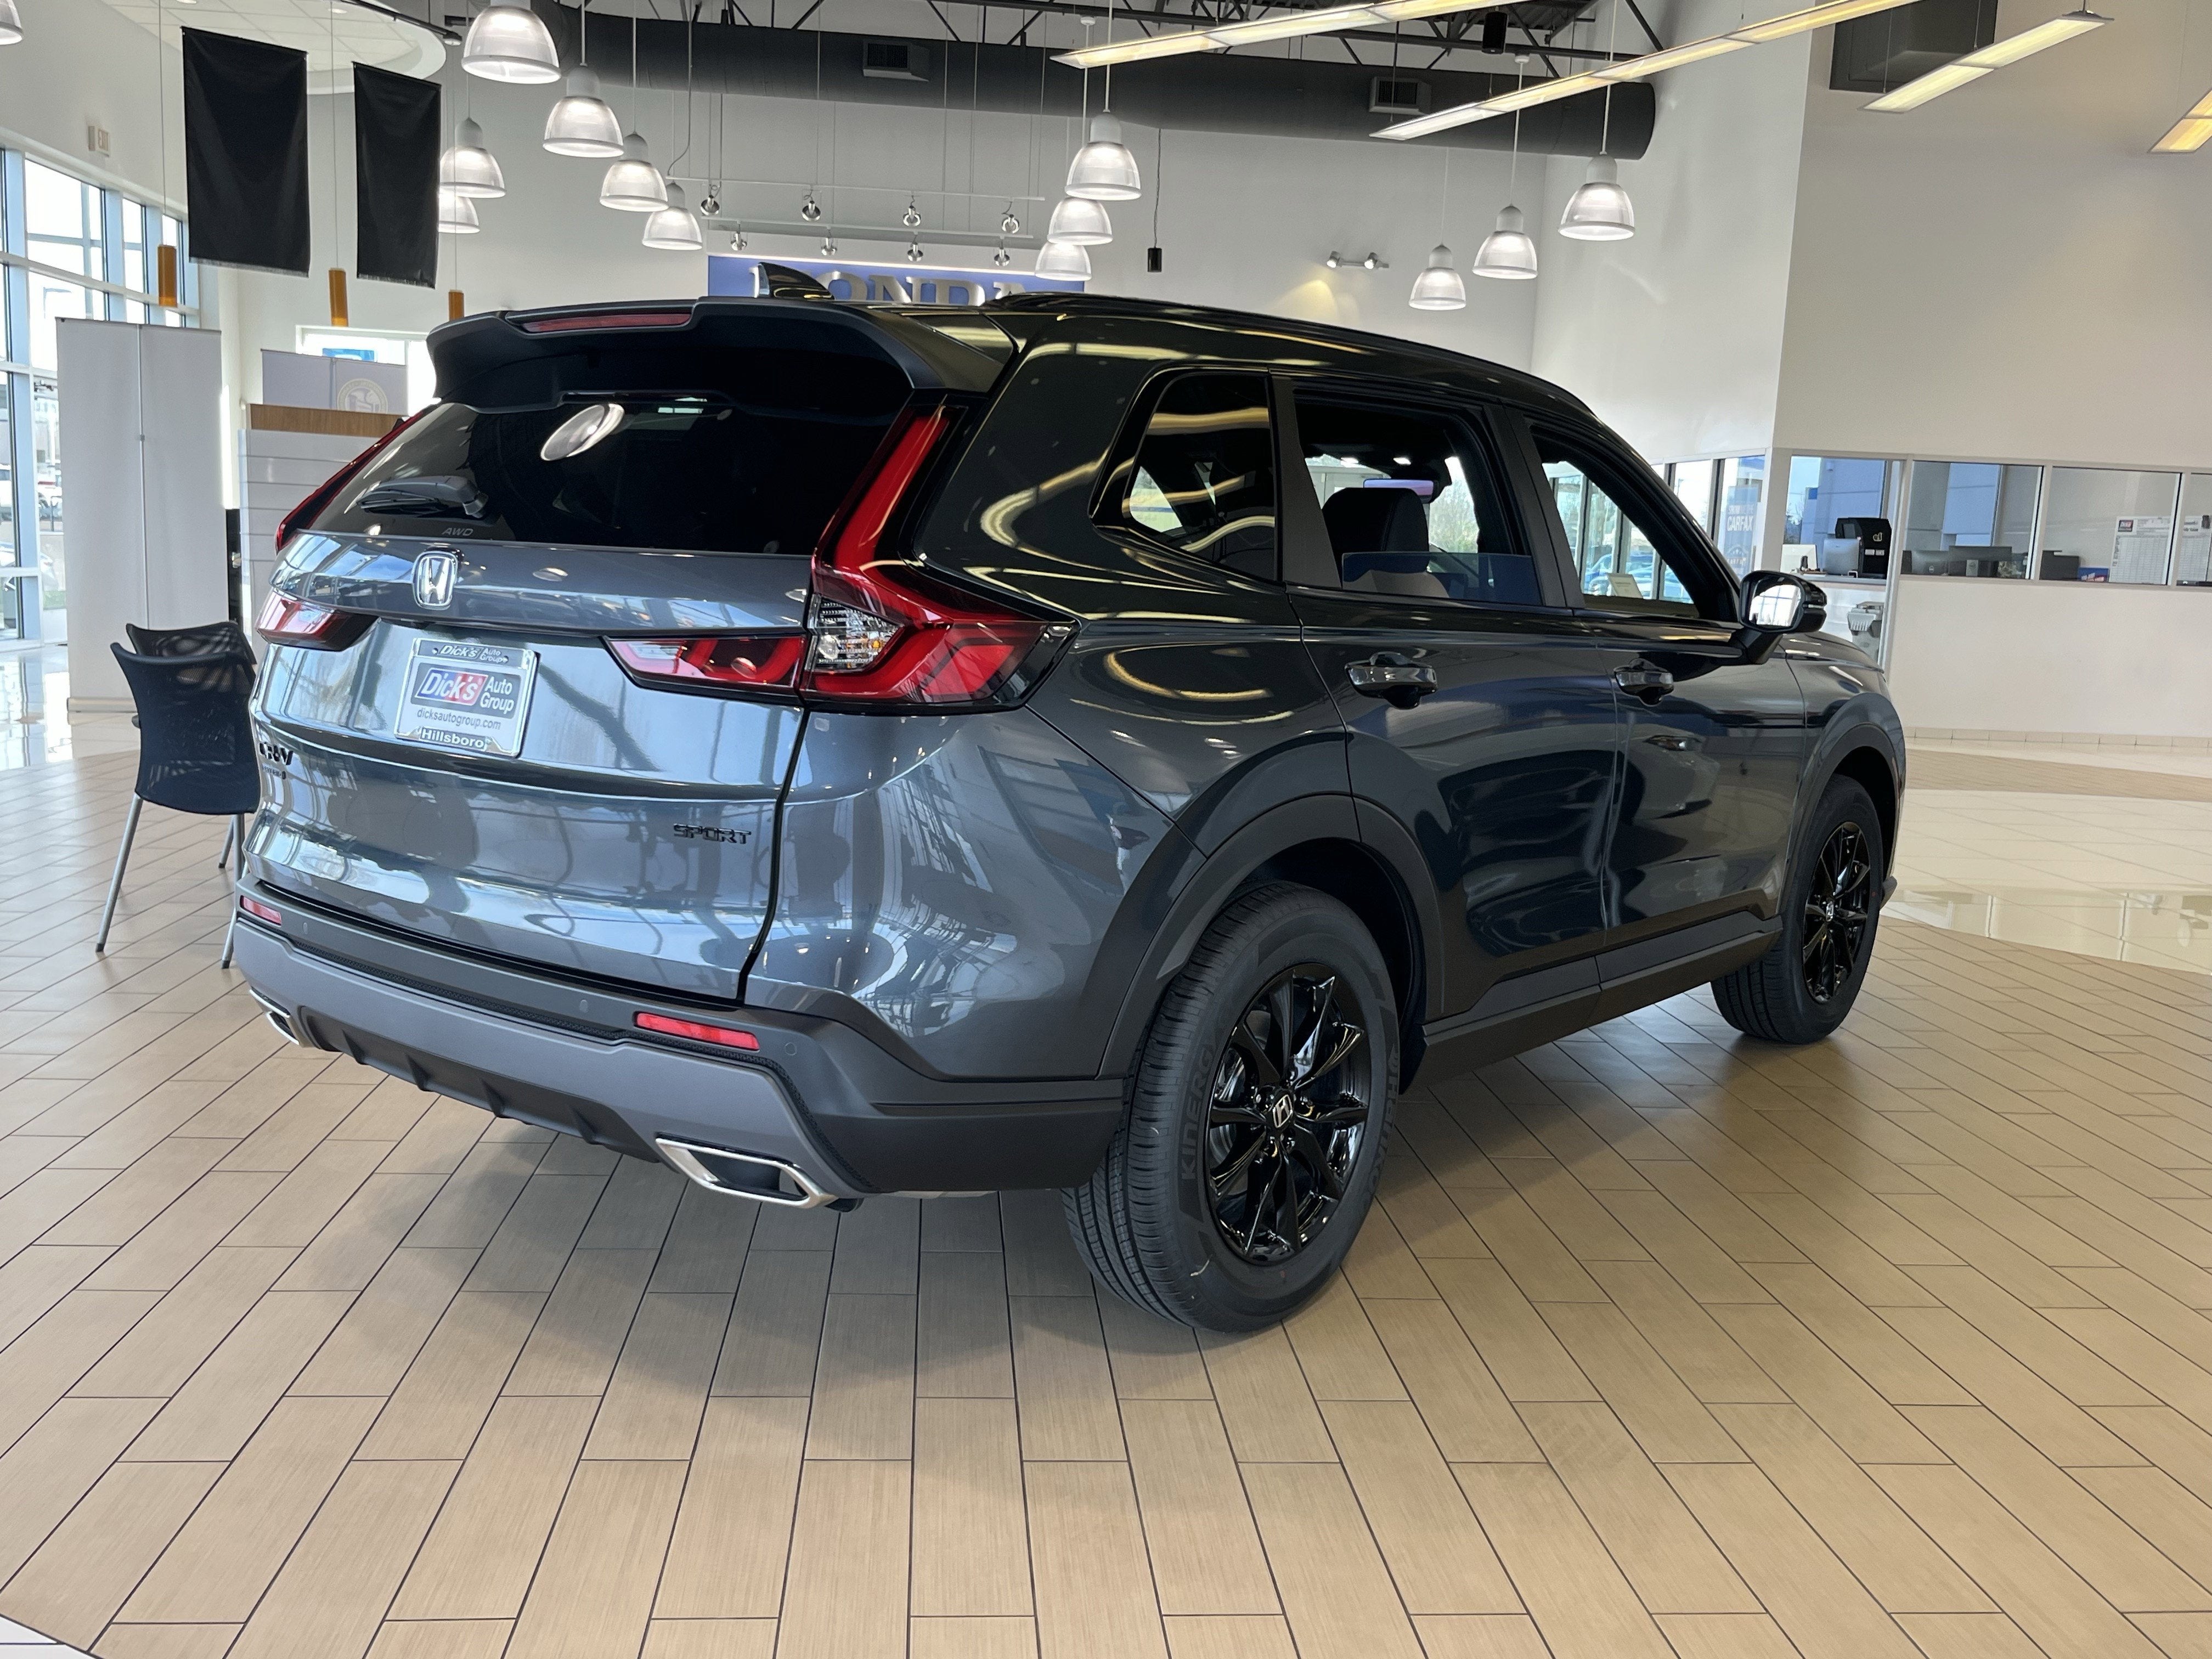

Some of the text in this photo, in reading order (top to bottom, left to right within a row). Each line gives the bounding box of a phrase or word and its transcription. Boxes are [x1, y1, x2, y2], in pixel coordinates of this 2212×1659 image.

[441, 527, 473, 537] AWD
[1727, 515, 1754, 531] CARFAX
[420, 673, 478, 701] Dick's
[485, 676, 513, 695] Auto
[480, 692, 515, 715] Group
[416, 707, 501, 730] dicksautogroup.com
[420, 729, 484, 747] Hillsboro
[674, 823, 752, 845] SPORT
